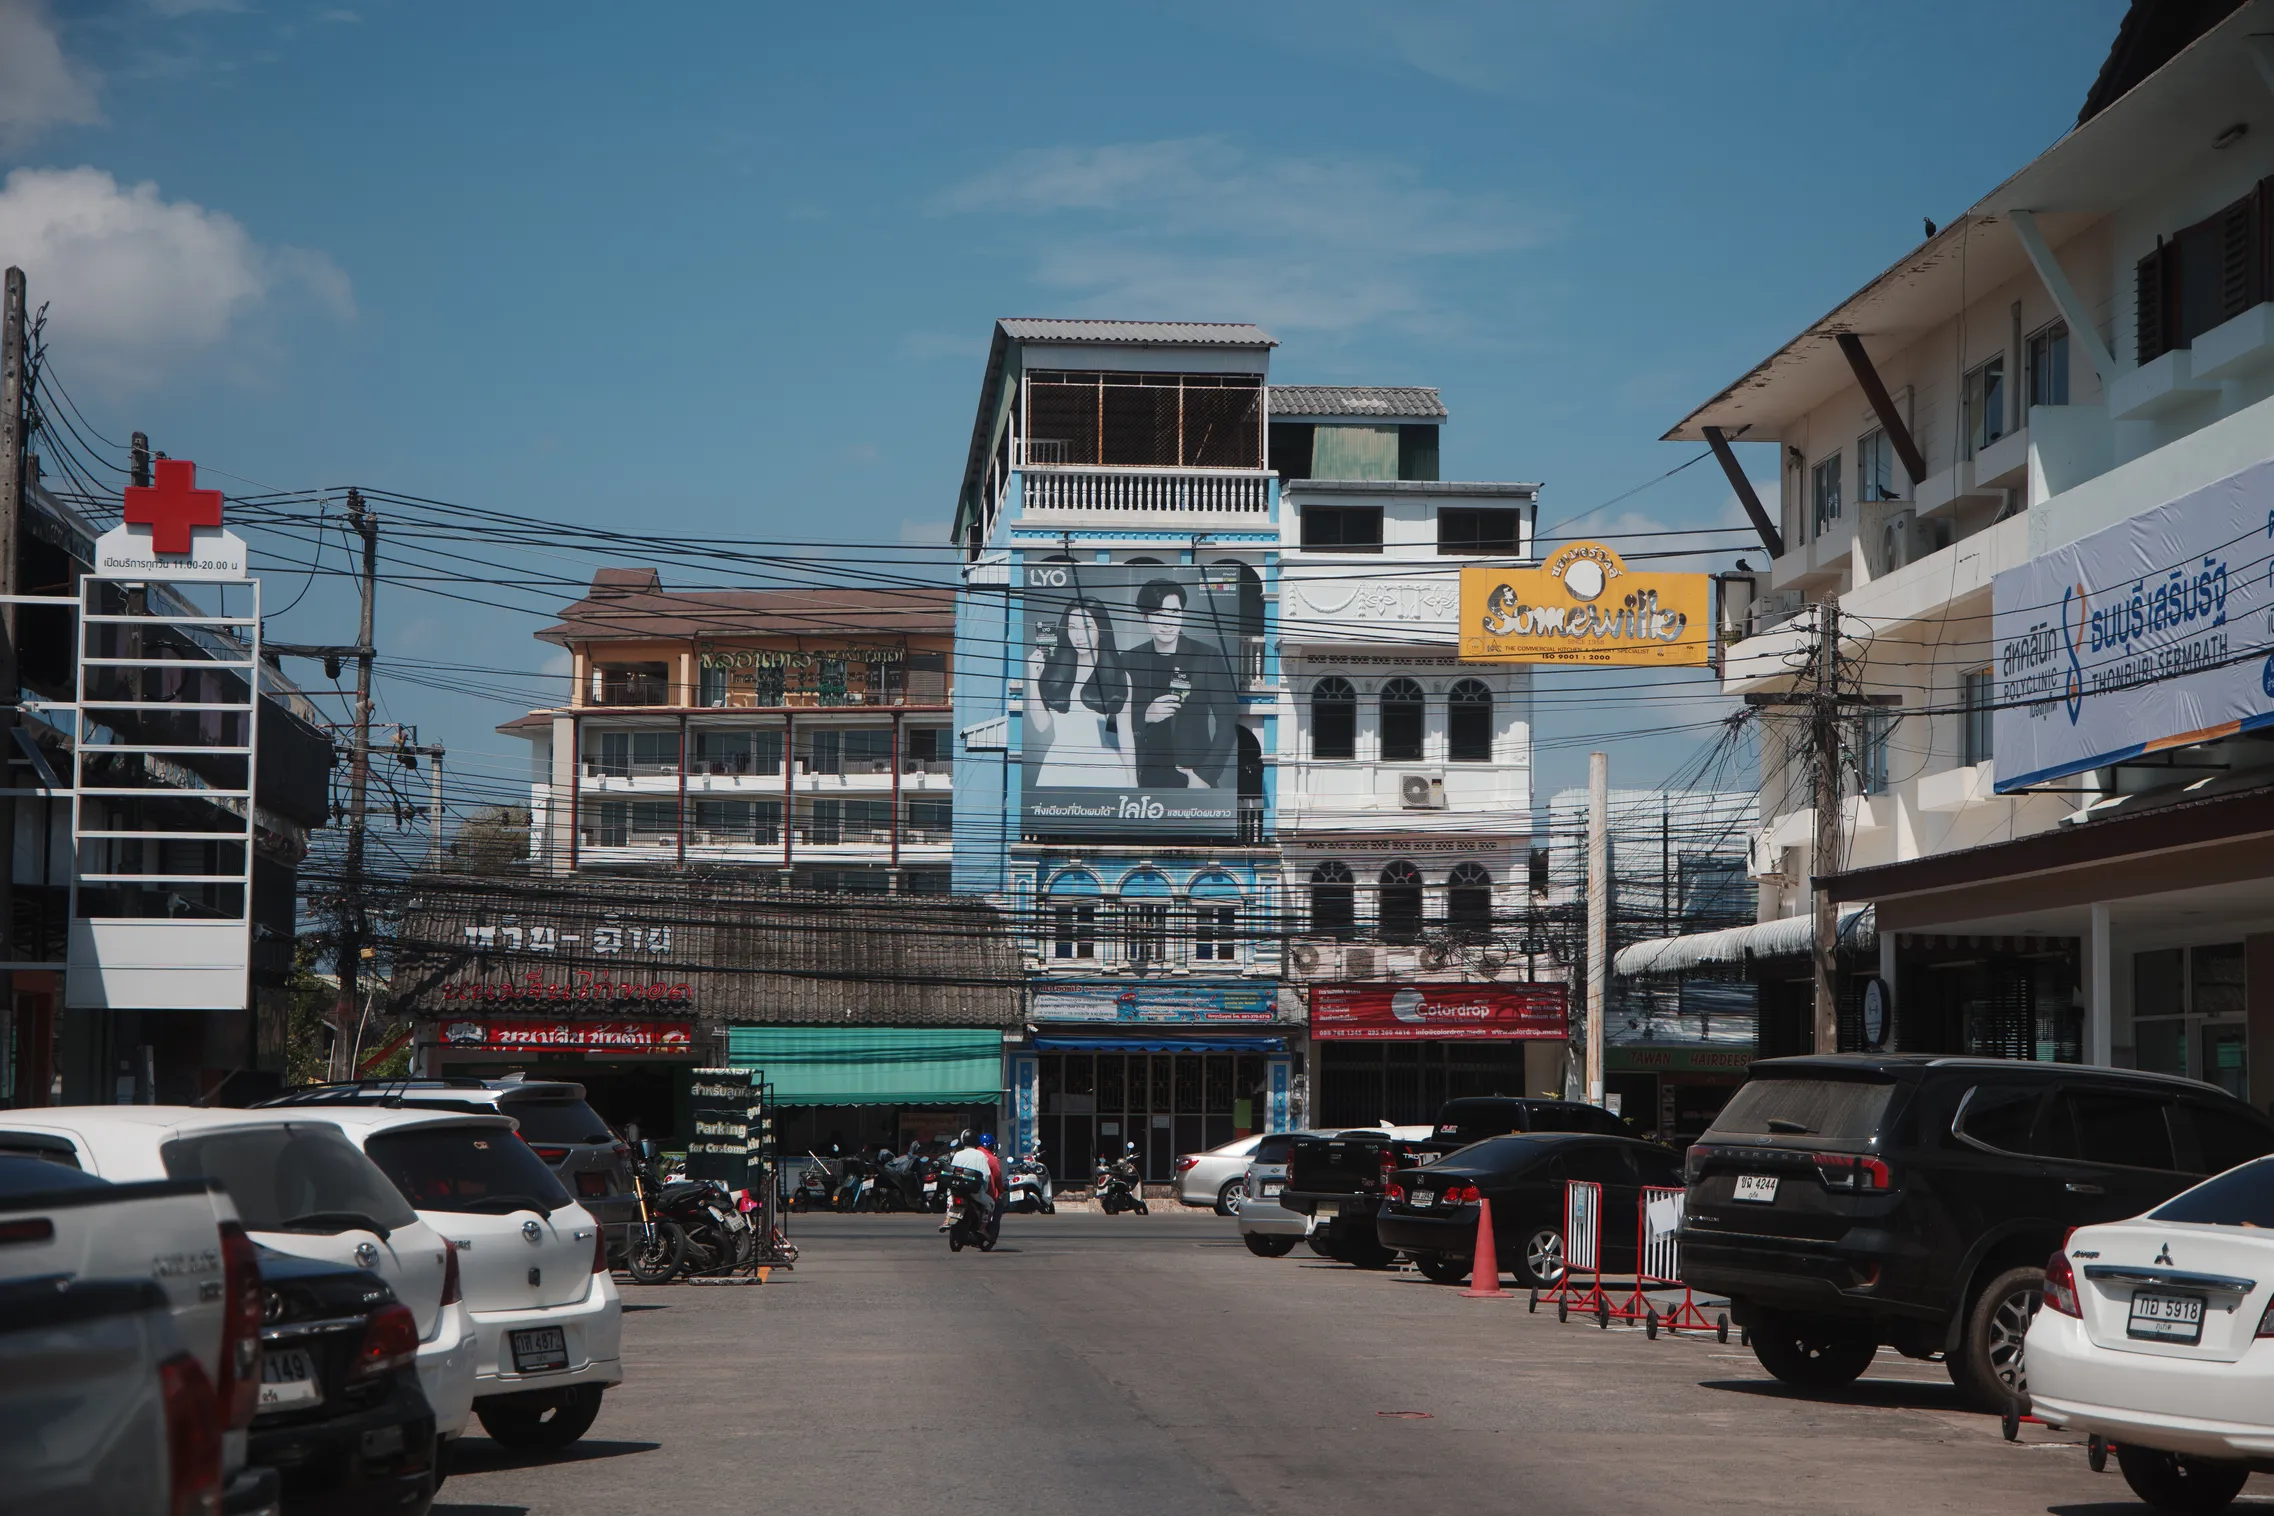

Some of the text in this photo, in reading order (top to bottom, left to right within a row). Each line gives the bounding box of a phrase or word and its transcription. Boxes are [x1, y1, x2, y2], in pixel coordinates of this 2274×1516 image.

[104, 557, 169, 571] เปิดบริการทุกวัน
[173, 560, 228, 571] 11.00-20.00
[1030, 569, 1067, 587] LYO
[1482, 583, 1687, 642] Somerville
[2003, 621, 2057, 677] สหคลินิก
[2092, 656, 2154, 699] THONBURI
[2158, 633, 2228, 676] SERMRATH
[2003, 667, 2058, 703] POLYCLINIC
[1118, 795, 1164, 820] ไลโอ
[1415, 1003, 1490, 1019] Colordrop
[1415, 1029, 1486, 1037] info@colordrop.media
[1491, 1028, 1562, 1036] www.colordrop.media
[1630, 1051, 1671, 1066] TAWAN
[695, 1121, 747, 1139] Parking
[688, 1142, 704, 1154] for
[1713, 1149, 1805, 1161] EVEREST
[1755, 1177, 1776, 1191] 4244
[2140, 1298, 2198, 1319] กอ 5918
